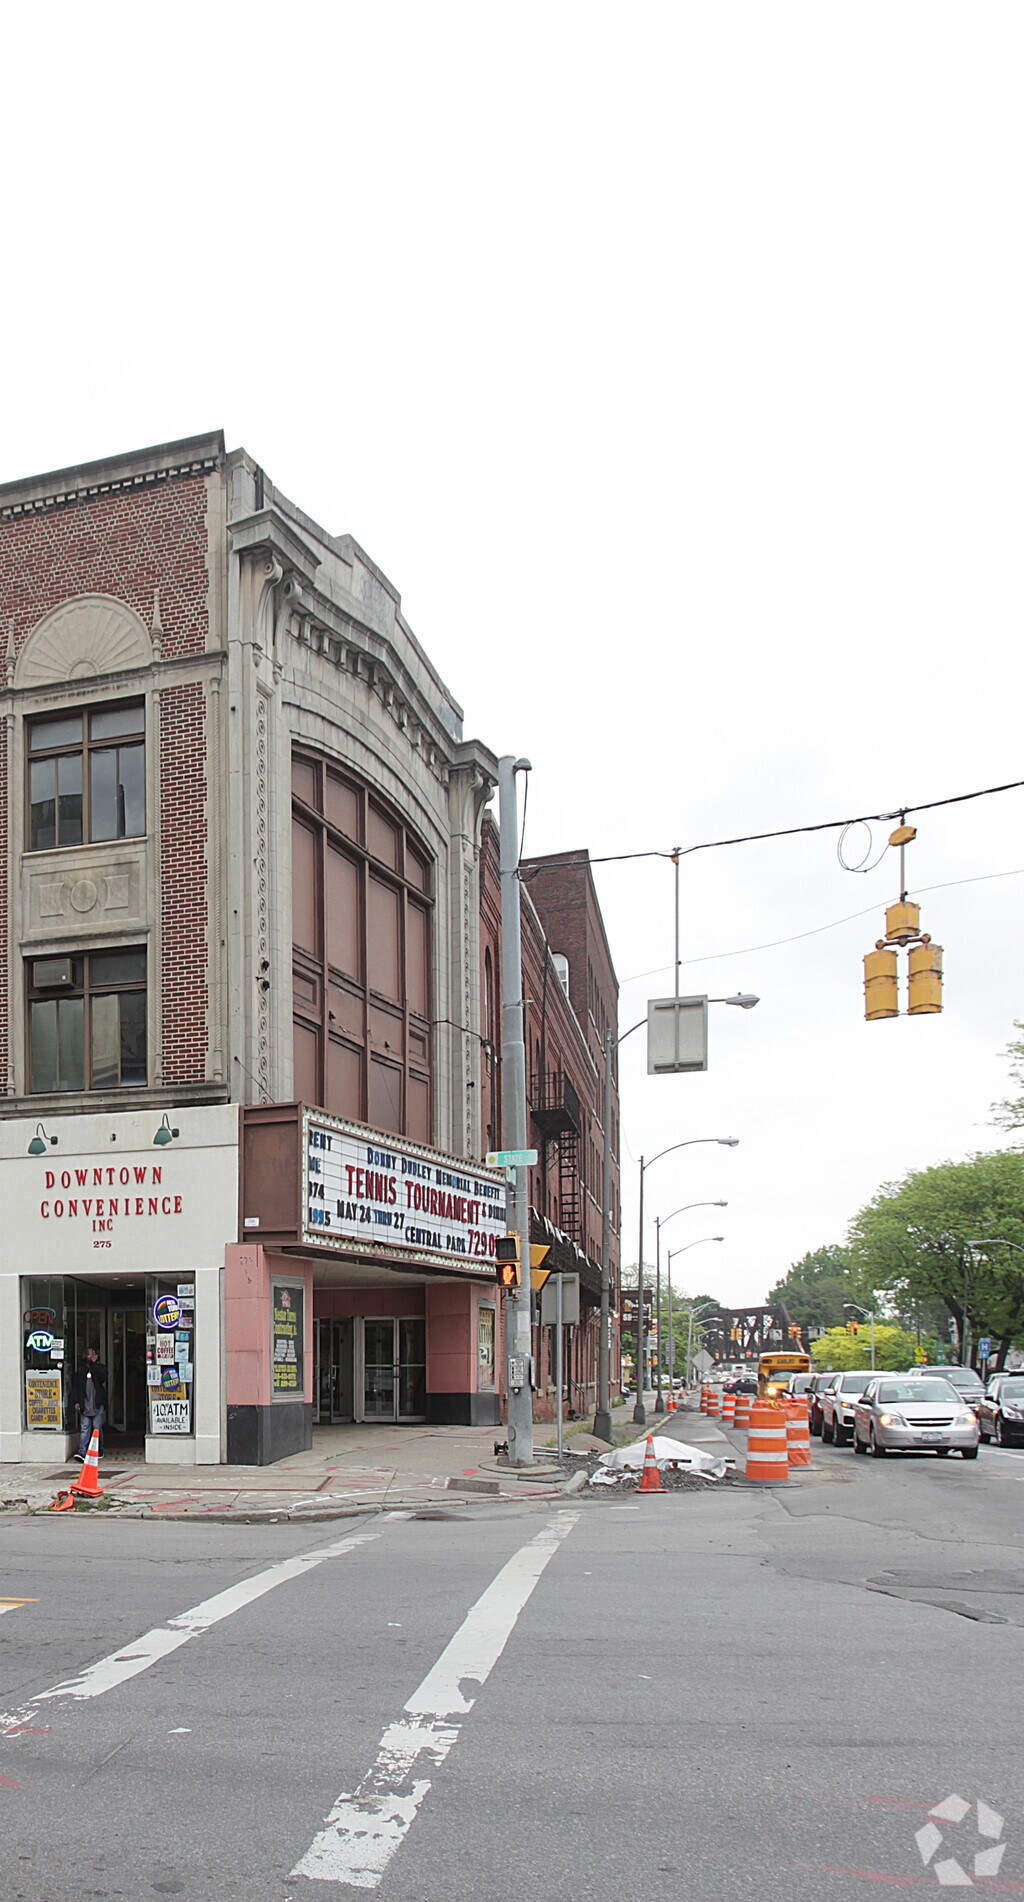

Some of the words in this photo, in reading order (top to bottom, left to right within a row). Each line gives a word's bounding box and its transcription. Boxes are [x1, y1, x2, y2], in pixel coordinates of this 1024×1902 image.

[503, 1154, 523, 1164] STATE
[45, 1166, 162, 1189] DOWNTOWN
[367, 1147, 396, 1170] DONNY
[401, 1157, 432, 1180] DUDLEY
[436, 1169, 471, 1193] MEMORIAL
[474, 1181, 500, 1200] BENEFIT
[345, 1164, 396, 1205] TENNIS
[405, 1180, 481, 1226] TOURNAMENT
[40, 1195, 183, 1218] CONVENIENCE
[337, 1199, 357, 1221] MAY
[359, 1204, 371, 1223] 24
[373, 1208, 392, 1227] THRU
[393, 1211, 405, 1230] 27
[92, 1218, 114, 1232] INC
[93, 1240, 112, 1248] 275
[405, 1225, 442, 1249] CENTRAL
[446, 1234, 466, 1253] PARK
[24, 1310, 54, 1325] OPEN
[26, 1335, 54, 1347] ATM
[35, 1389, 53, 1399] STORE
[168, 1403, 188, 1416] ATM
